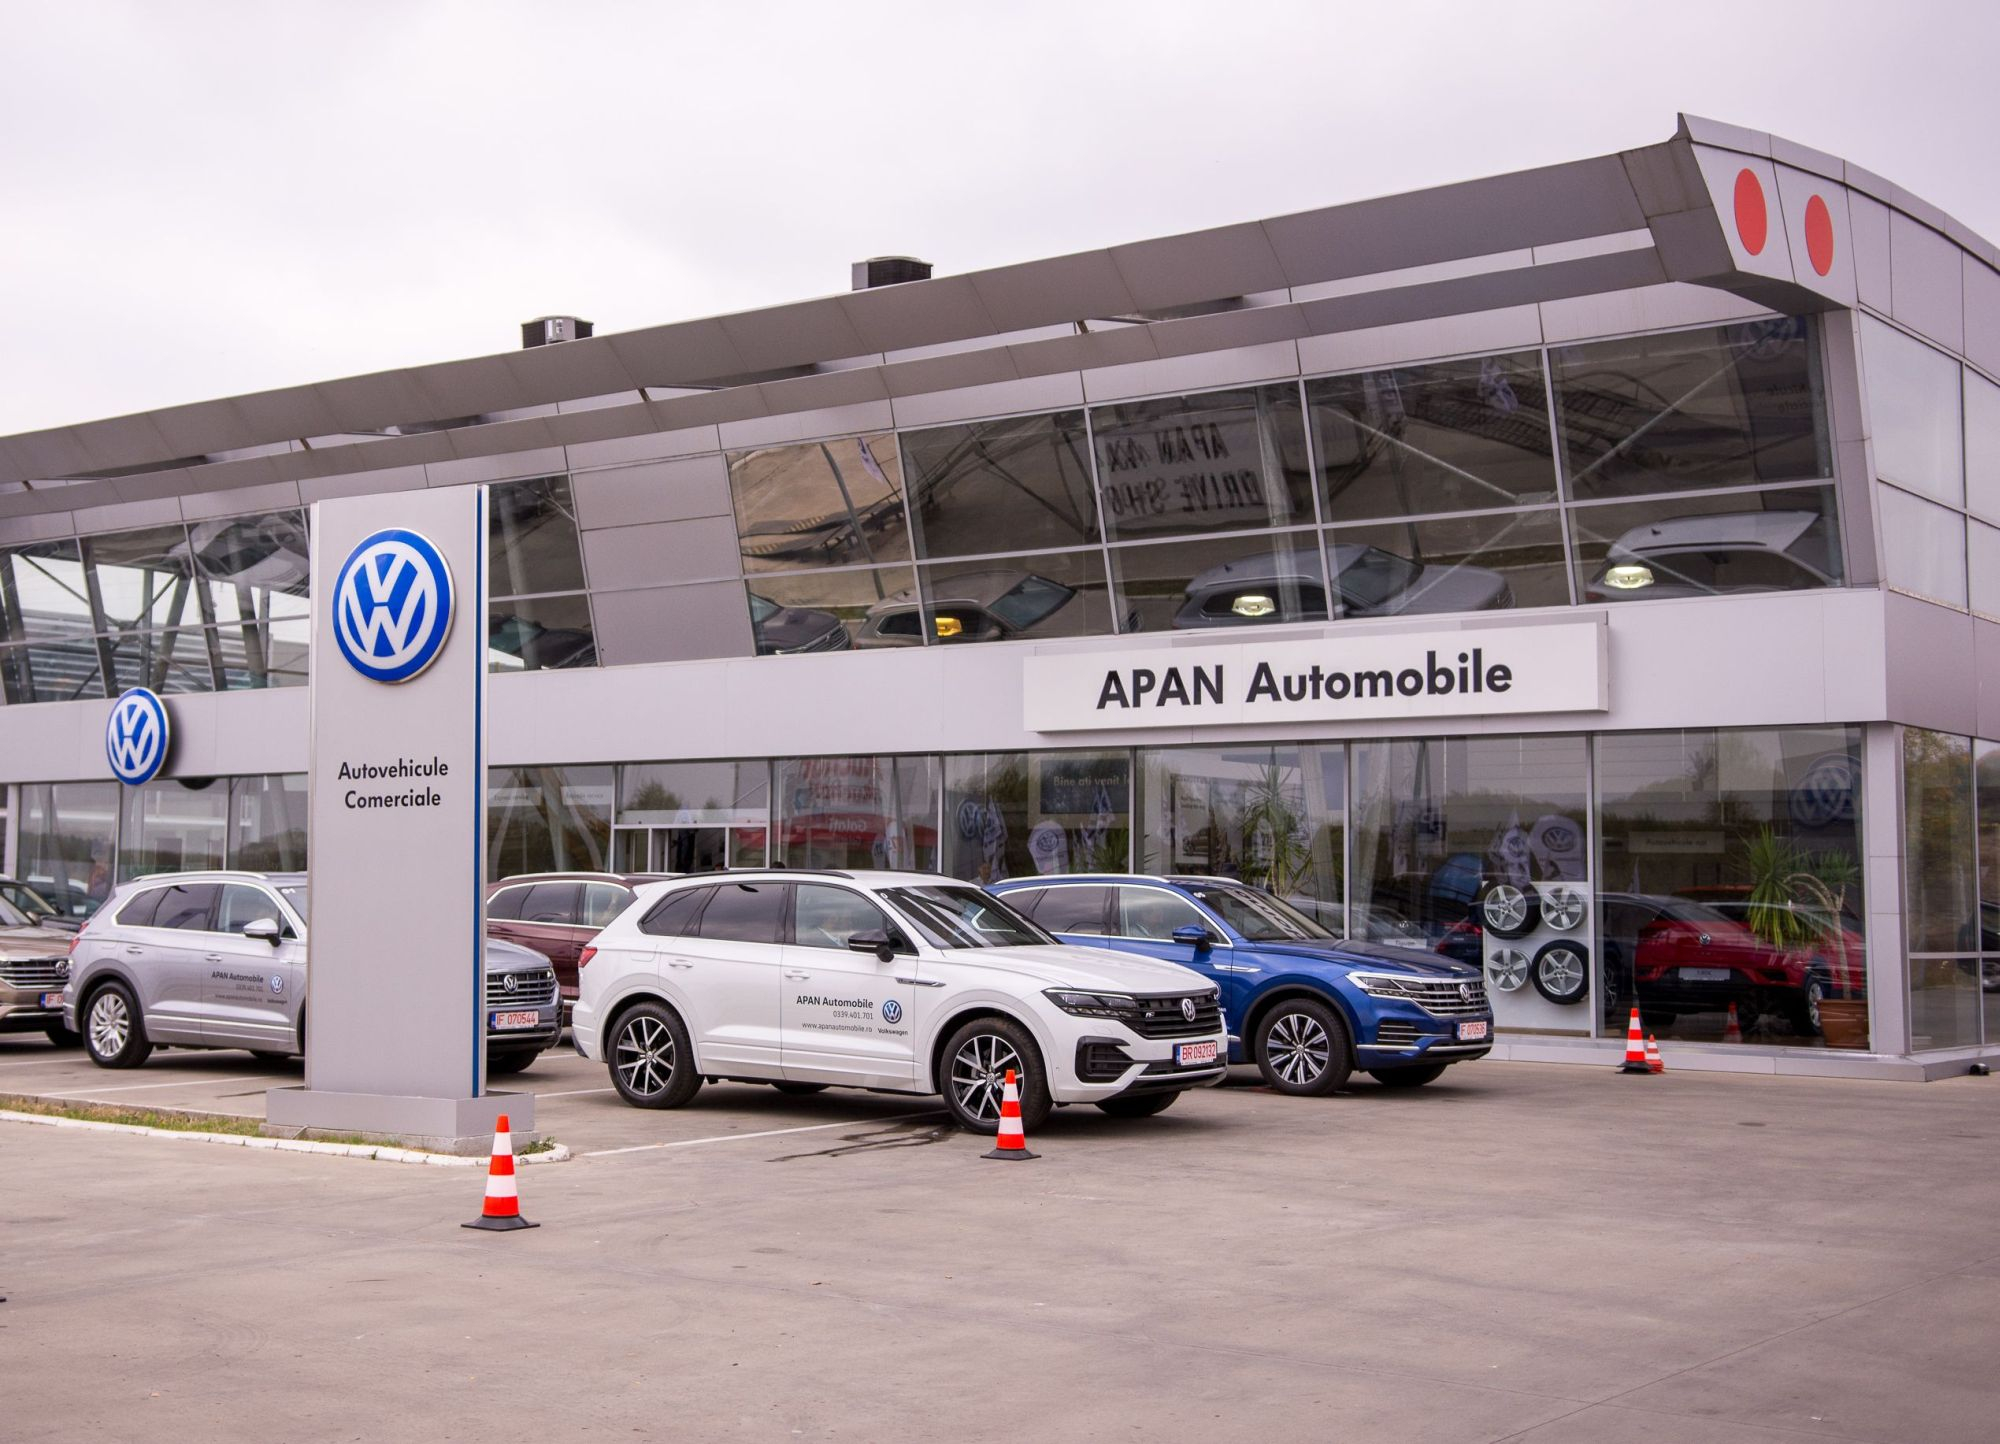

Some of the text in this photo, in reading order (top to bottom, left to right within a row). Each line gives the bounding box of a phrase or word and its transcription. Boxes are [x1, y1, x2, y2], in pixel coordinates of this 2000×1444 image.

[1096, 648, 1513, 709] APAN Automobile
[337, 756, 449, 781] Autovehicule
[344, 787, 441, 810] Comerciale
[212, 971, 264, 983] APAN Automobile
[796, 995, 874, 1009] APAN Automobile
[497, 1012, 536, 1025] IF 070544
[877, 1027, 909, 1036] Volkswagen
[1182, 1044, 1217, 1060] BR 092132
